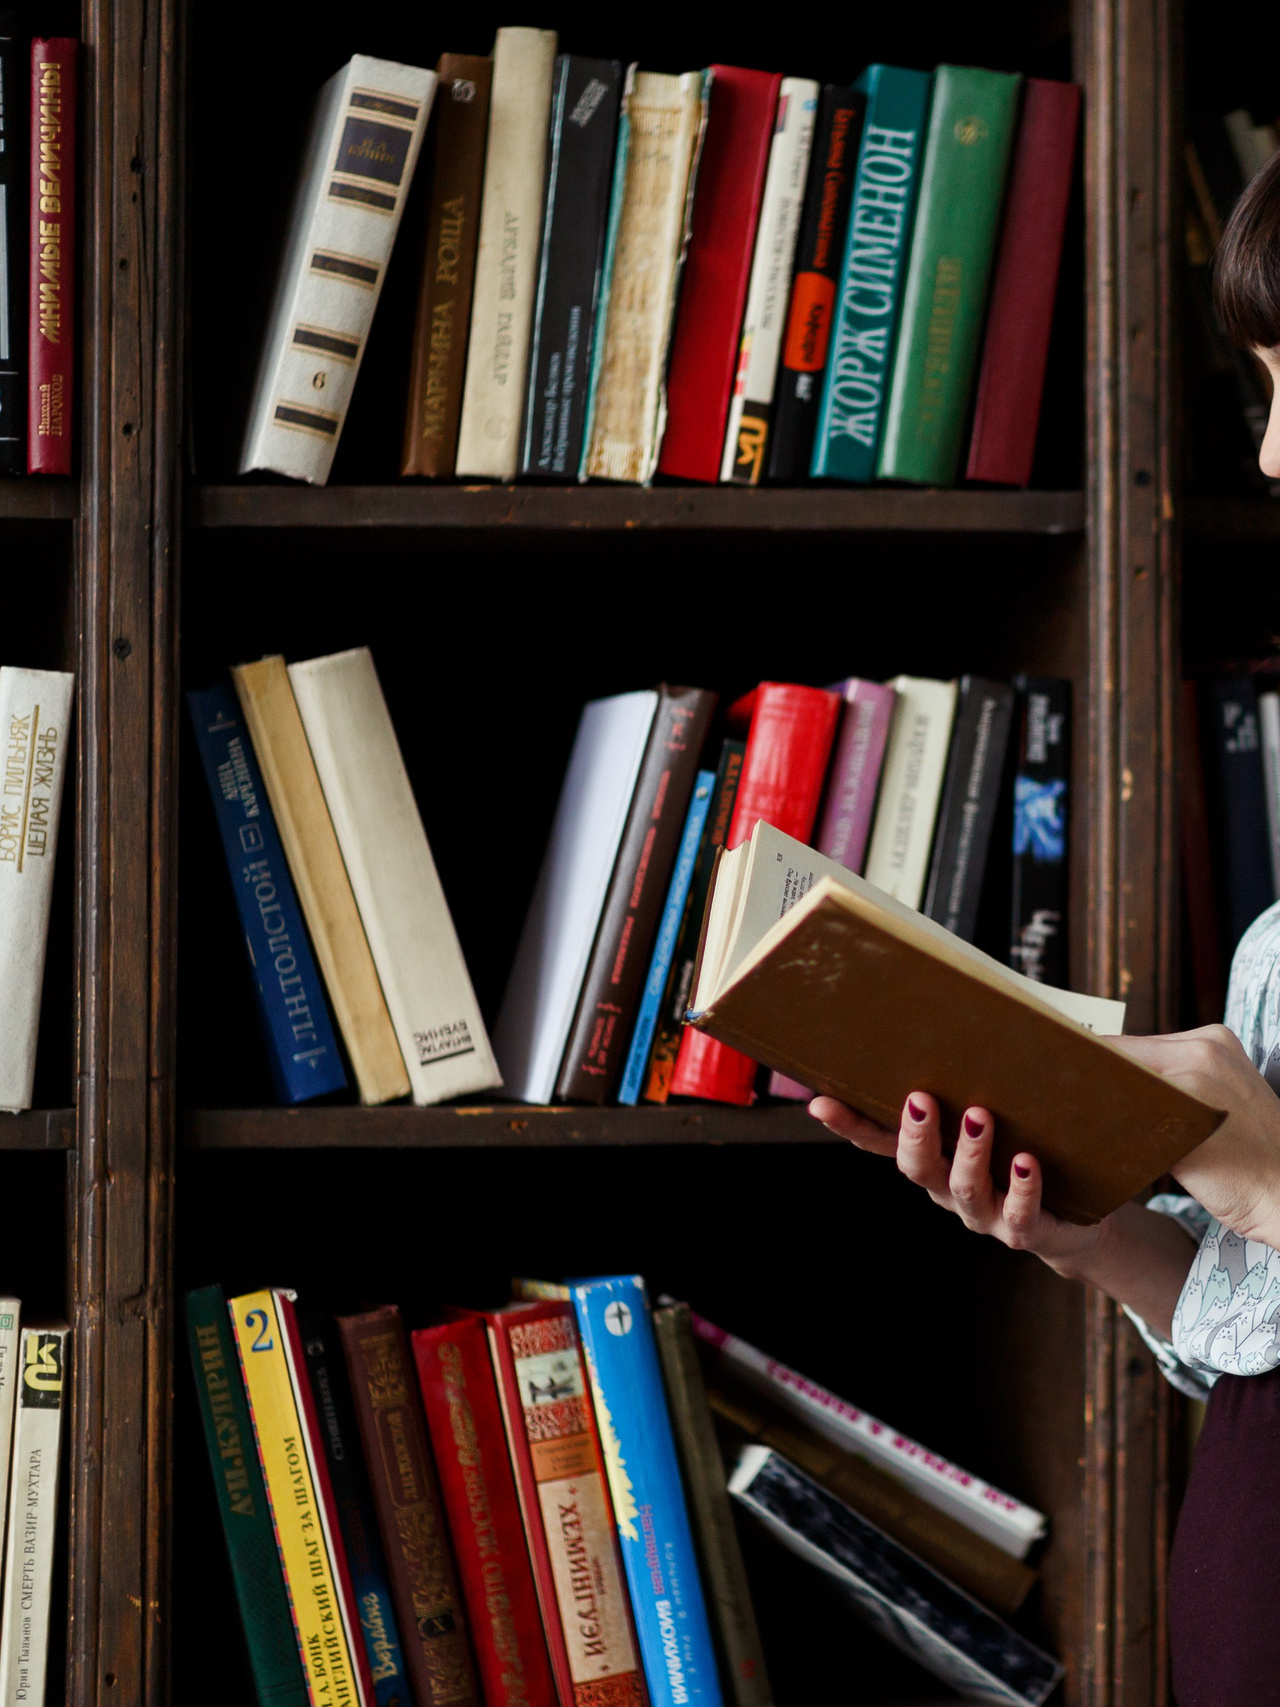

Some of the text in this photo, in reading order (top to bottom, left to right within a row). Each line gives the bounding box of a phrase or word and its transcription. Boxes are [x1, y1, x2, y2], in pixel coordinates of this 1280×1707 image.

[38, 62, 62, 343] МНИМЫЕ ВЕЛИЧИНЫ
[423, 196, 465, 442] МАРЬИНА РОЩА
[828, 124, 914, 446] ЖОРЖ СИМЕНОН
[38, 384, 51, 436] Николай
[312, 370, 325, 391] 6
[4, 714, 30, 796] ПИЛЬНЯК
[27, 727, 57, 856] ЦЕЛАЯ ЖИЗНЬ
[245, 1309, 274, 1353] 2
[282, 1435, 309, 1506] ШАГОМ
[299, 1509, 314, 1531] ЗА
[304, 1539, 324, 1579] ШАГ
[16, 1448, 41, 1701] Юрий Тынянов СМЕРТЬ ВАЗИР-МУХТАРА
[558, 1500, 604, 1658] ХЕМИНГУЭЙ
[306, 1633, 326, 1677] БОНК
[656, 1600, 688, 1704] БИОХИМИЯ
